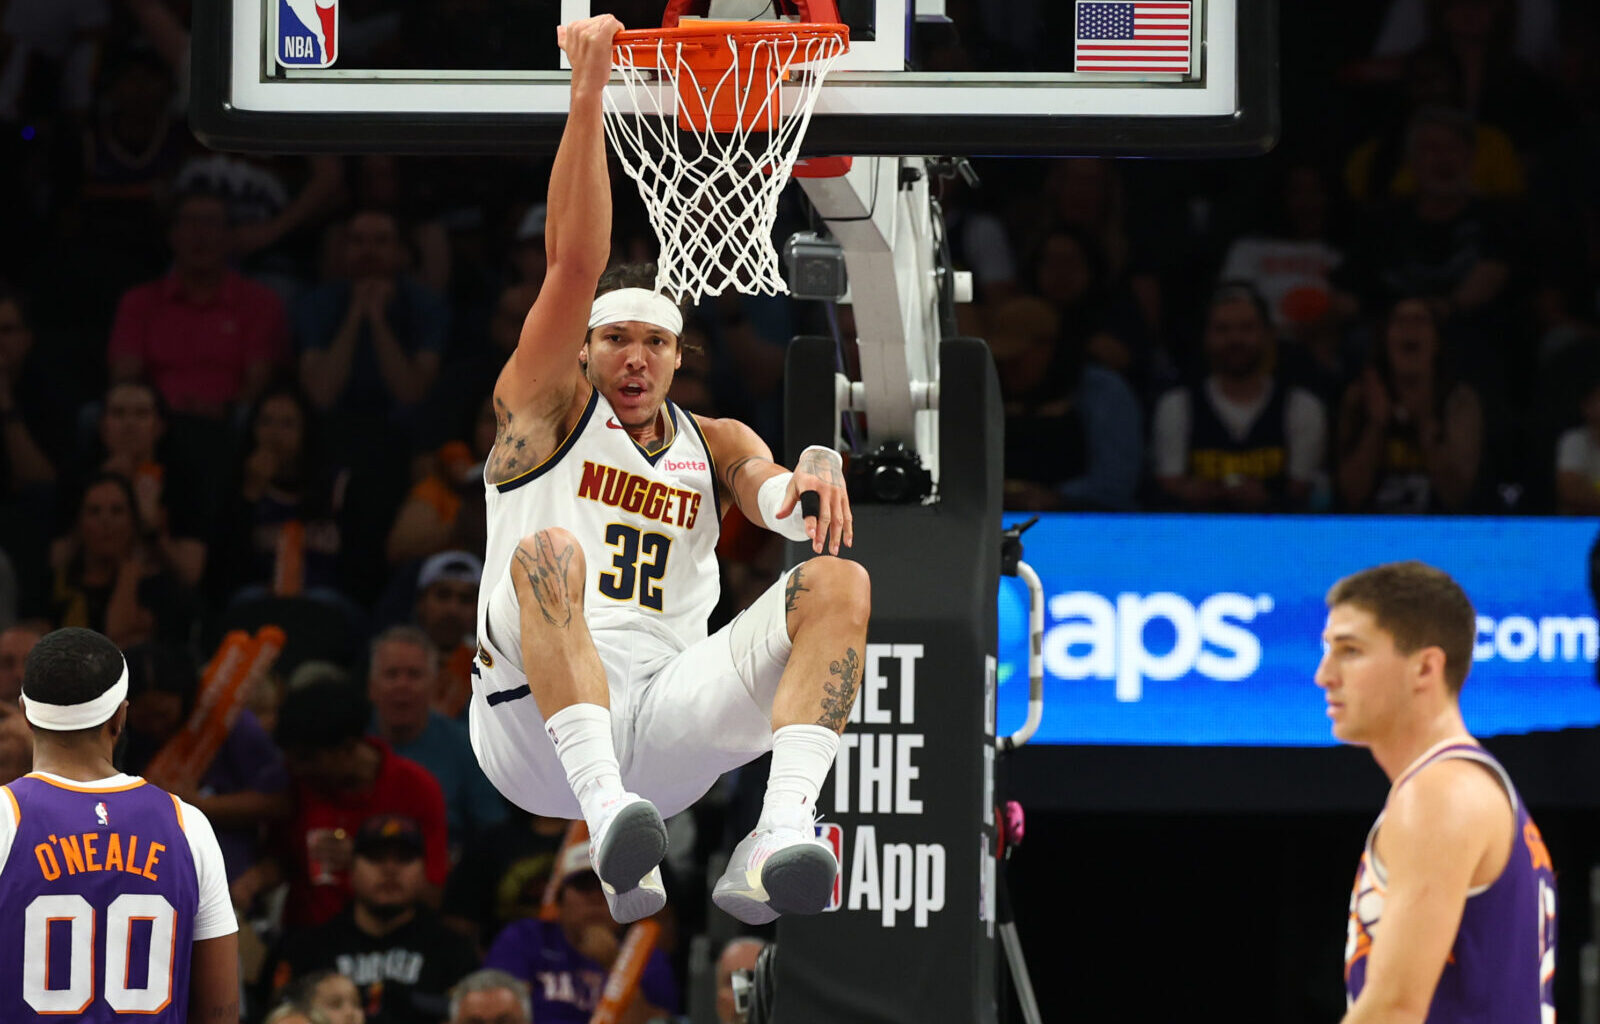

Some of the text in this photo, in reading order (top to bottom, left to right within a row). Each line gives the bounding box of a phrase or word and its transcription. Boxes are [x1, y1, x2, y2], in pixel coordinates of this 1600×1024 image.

[285, 36, 314, 58] NBA
[578, 460, 702, 530] NUGGETS
[664, 459, 706, 471] ibotta
[598, 522, 674, 614] 32
[846, 643, 924, 724] ET
[1042, 591, 1262, 702] aps
[835, 733, 925, 814] THE
[34, 832, 166, 882] O'NEALE
[848, 825, 946, 928] App
[23, 893, 178, 1015] 00
